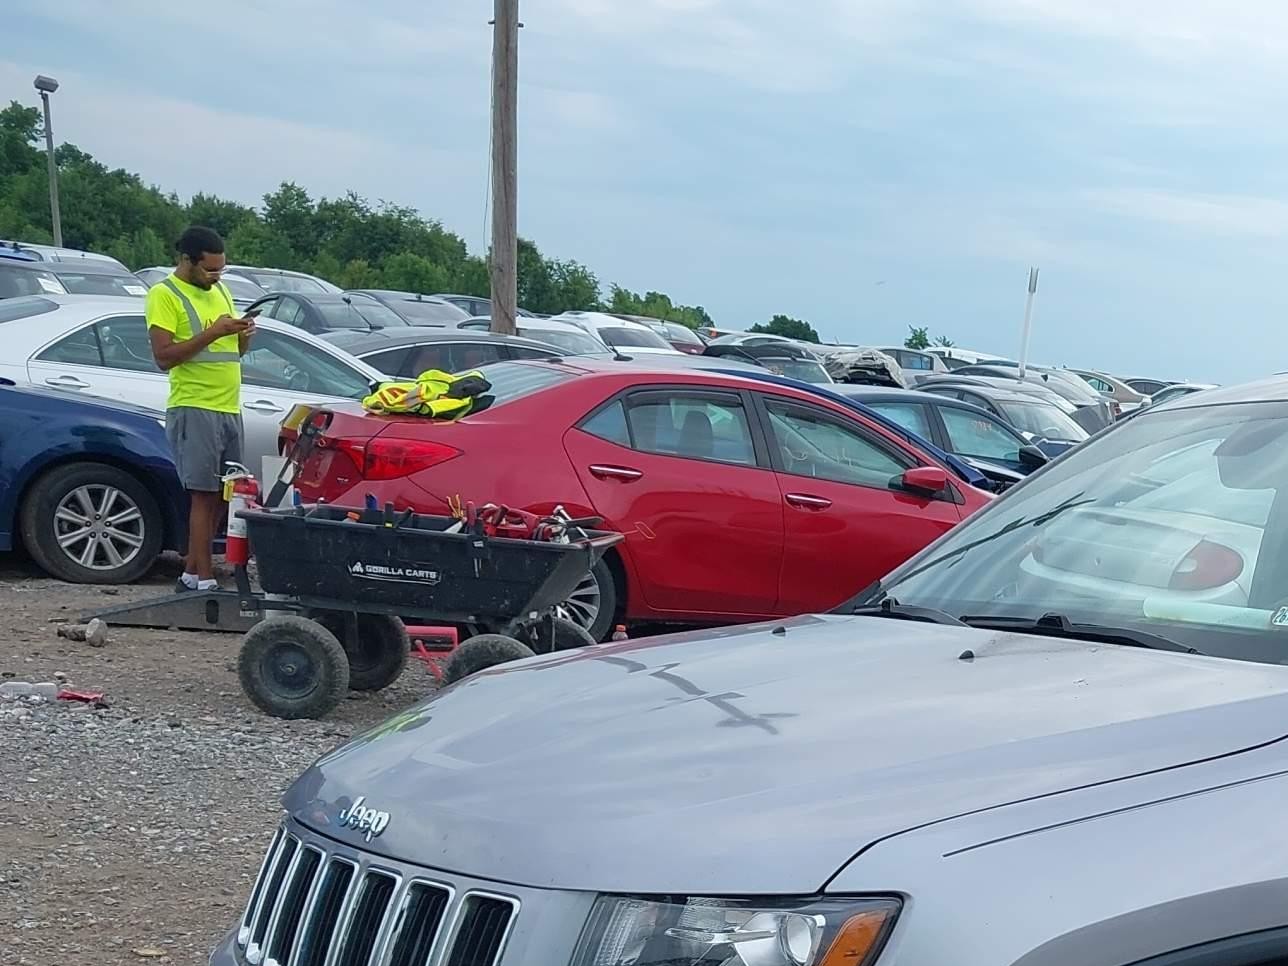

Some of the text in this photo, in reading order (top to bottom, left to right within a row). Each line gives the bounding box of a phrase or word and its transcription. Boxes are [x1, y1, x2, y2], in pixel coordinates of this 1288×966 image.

[365, 564, 437, 579] GORILLA CARTS
[339, 795, 391, 842] Jeep
